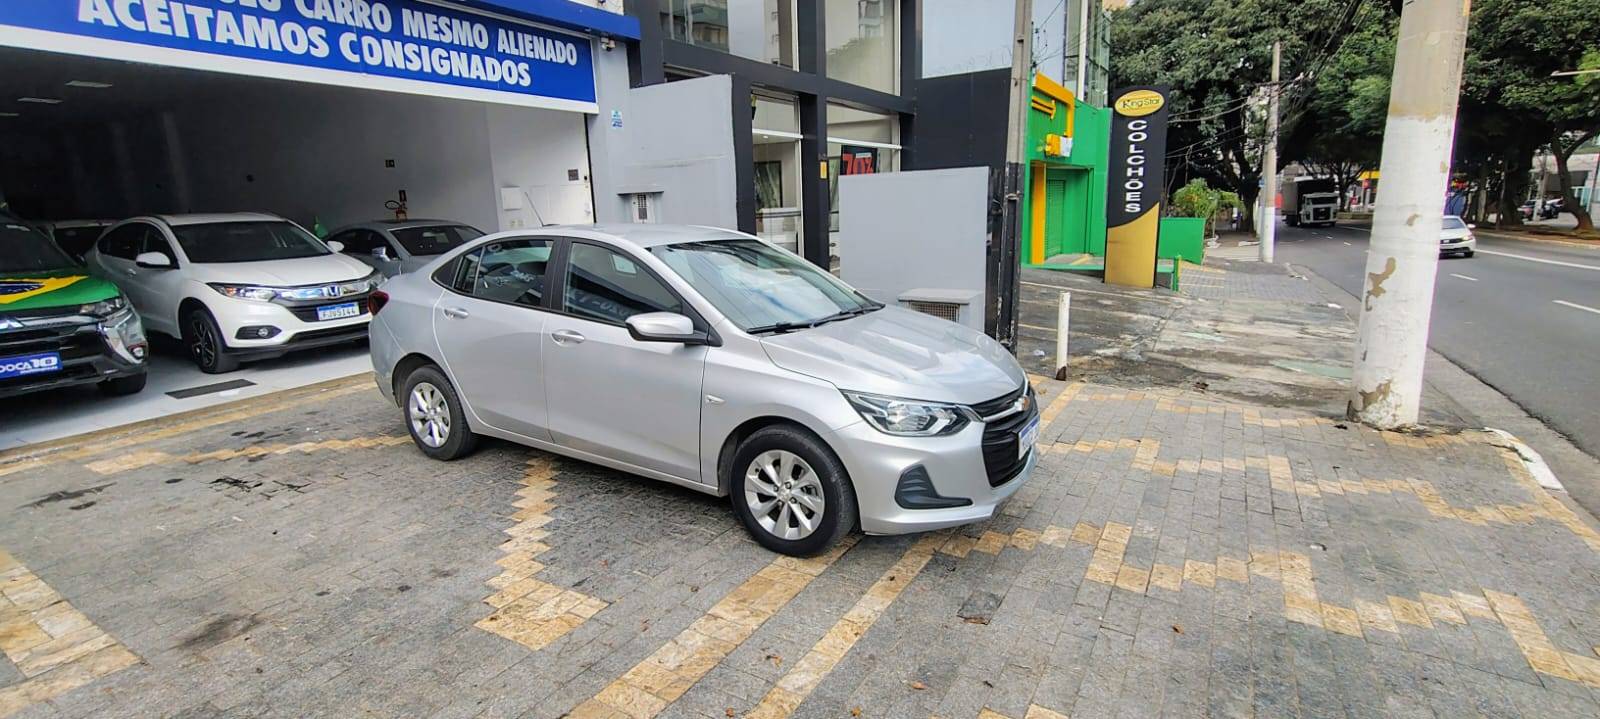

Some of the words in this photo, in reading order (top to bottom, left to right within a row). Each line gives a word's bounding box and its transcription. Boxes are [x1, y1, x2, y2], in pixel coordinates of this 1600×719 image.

[77, 0, 329, 58] ACEITAMOS
[339, 31, 531, 87] CONSIGNADOS
[402, 8, 489, 49] MESMO
[498, 28, 577, 66] ALIENADO
[1124, 119, 1148, 213] COLCHÕES
